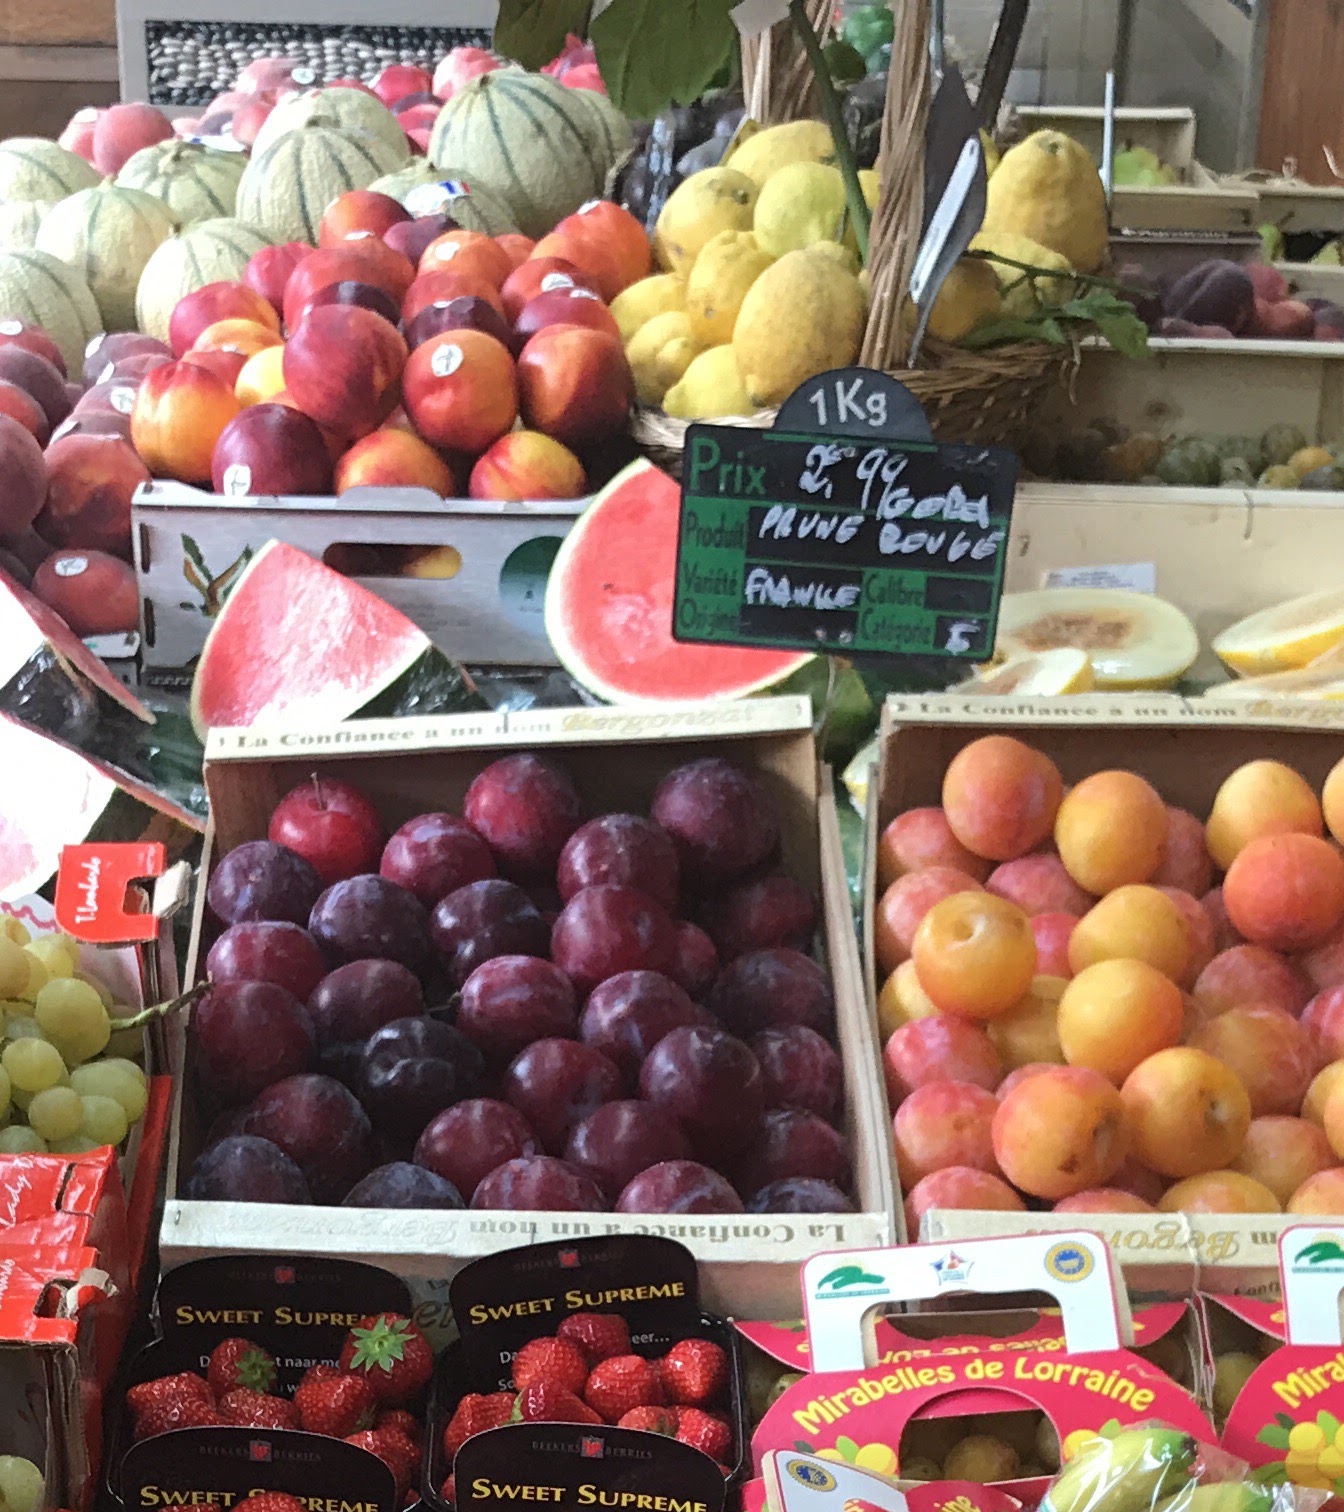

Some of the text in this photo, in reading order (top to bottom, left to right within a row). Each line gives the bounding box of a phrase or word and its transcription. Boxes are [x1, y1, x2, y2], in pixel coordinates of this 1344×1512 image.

[689, 438, 767, 495] Prix
[758, 504, 865, 544] PRUNE
[879, 523, 1006, 563] ROUGE
[962, 702, 1098, 716] Confiance
[237, 735, 269, 749] La
[279, 728, 415, 748] Confiance
[469, 1217, 538, 1233] nom
[809, 1222, 847, 1242] La
[470, 1296, 556, 1326] SWEET
[565, 1281, 686, 1310] SUPREME
[273, 1306, 364, 1327] SUPRE
[631, 1331, 672, 1345] eer...
[793, 1356, 1157, 1436] Mirabelles de Lorraine
[472, 1478, 567, 1503] SWEET
